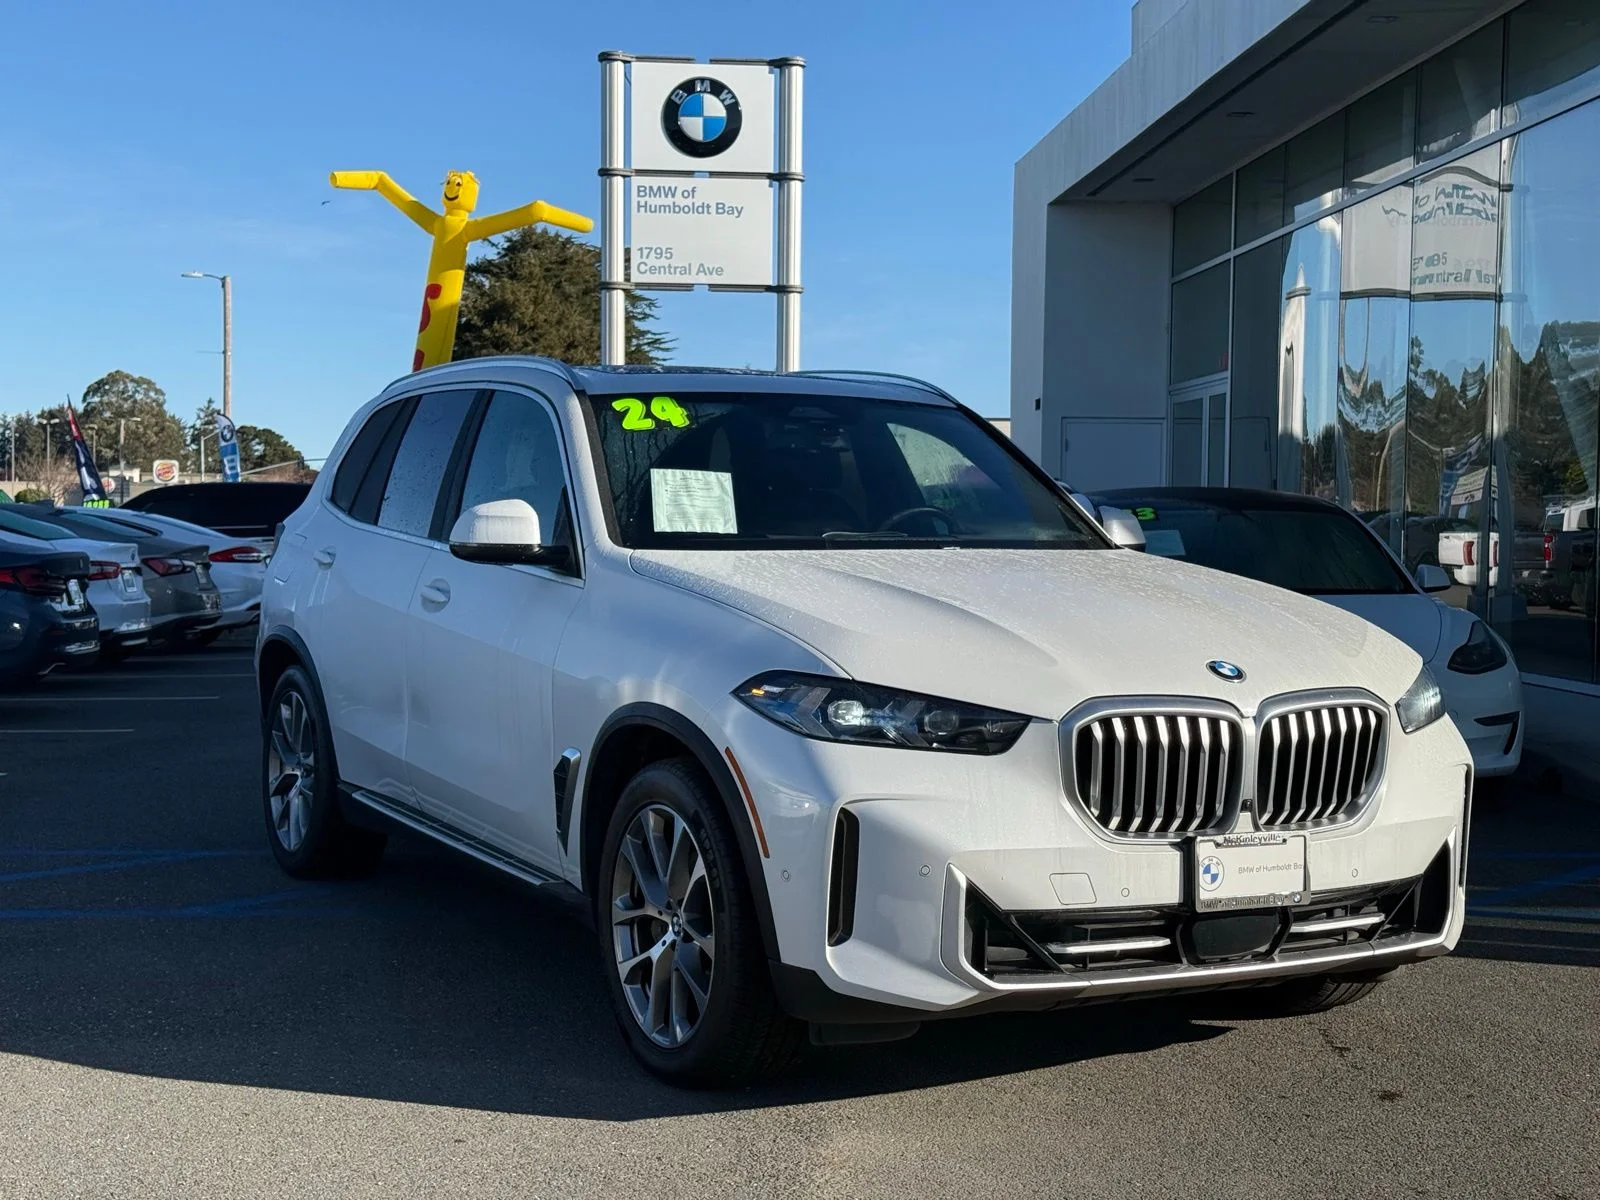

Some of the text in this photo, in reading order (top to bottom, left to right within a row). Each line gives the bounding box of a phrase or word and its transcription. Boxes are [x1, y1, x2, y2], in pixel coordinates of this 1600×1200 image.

[670, 79, 736, 106] BMW
[636, 185, 697, 199] BMW of
[636, 200, 744, 219] Humboldt Bay
[637, 246, 673, 260] 1795
[636, 262, 724, 276] Central Ave
[611, 396, 690, 431] 24
[1223, 833, 1281, 844] McKinleyville
[1238, 862, 1303, 875] BMW of Humboldt Ba
